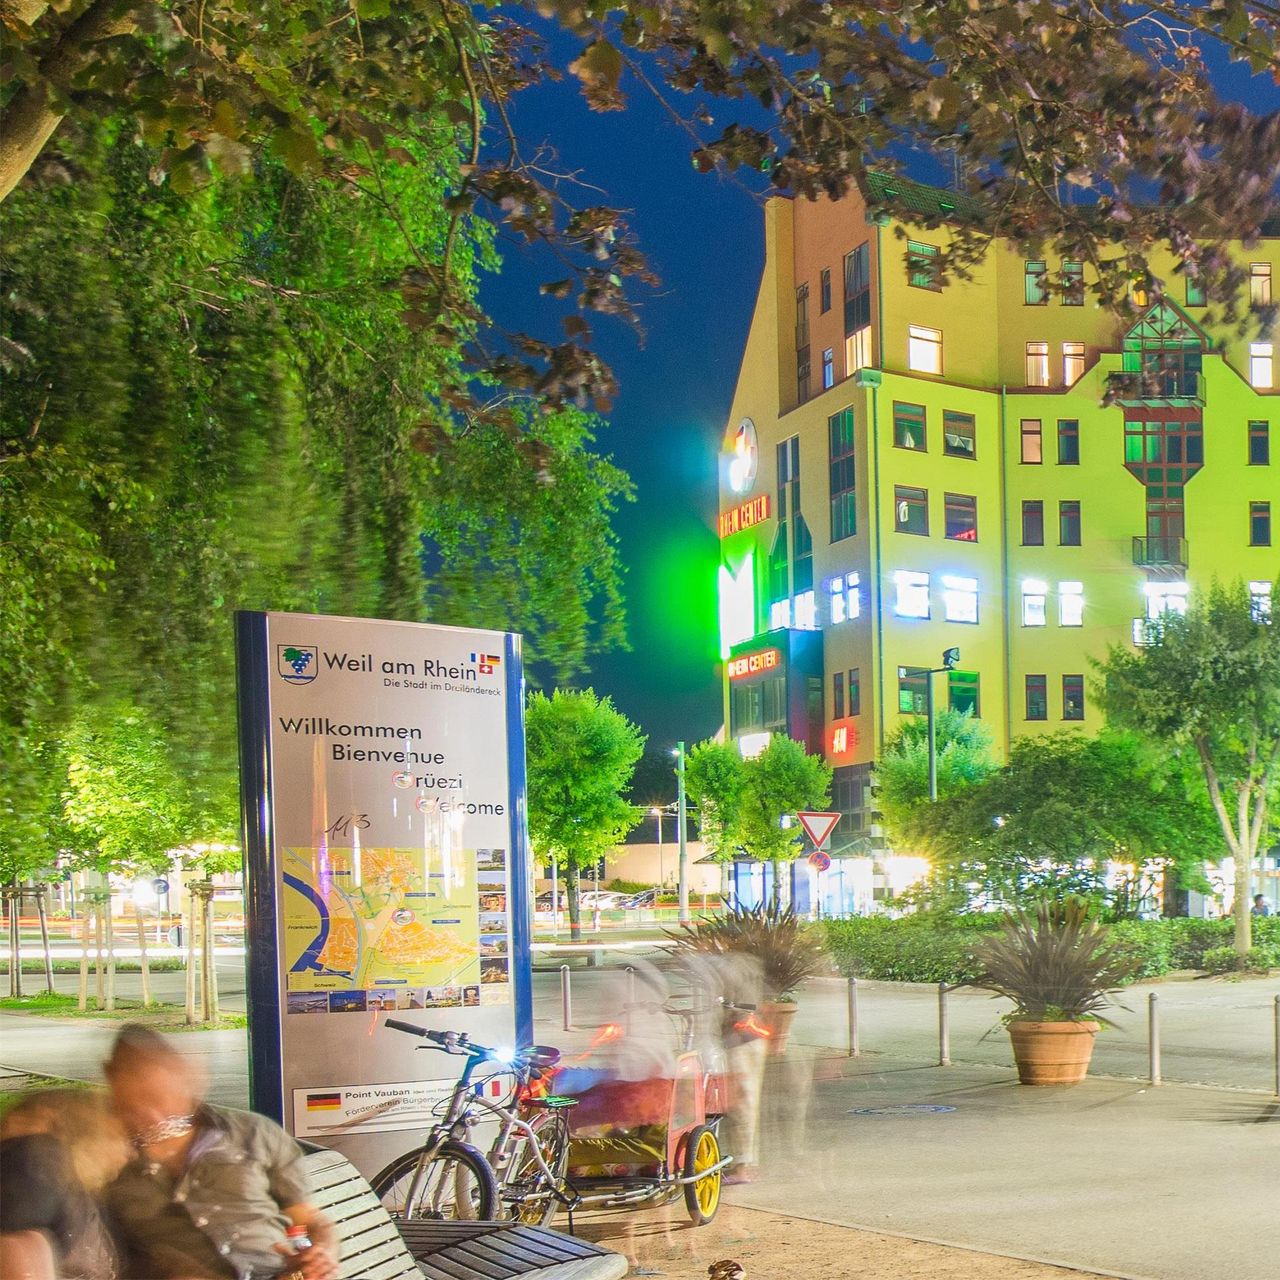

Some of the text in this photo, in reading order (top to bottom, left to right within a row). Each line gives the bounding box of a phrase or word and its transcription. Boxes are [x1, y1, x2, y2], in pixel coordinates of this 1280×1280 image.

[740, 495, 767, 529] CENTER
[323, 652, 477, 681] Weil am Rhein
[749, 651, 776, 672] CENTER
[383, 678, 400, 688] Die
[403, 679, 427, 690] Stadt
[430, 682, 442, 691] im
[279, 717, 422, 740] Willkommen
[332, 744, 445, 764] Bienvenue
[405, 773, 462, 789] rüezi
[428, 796, 504, 816] elcome
[345, 1091, 372, 1100] Point
[374, 1088, 410, 1098] Vauban
